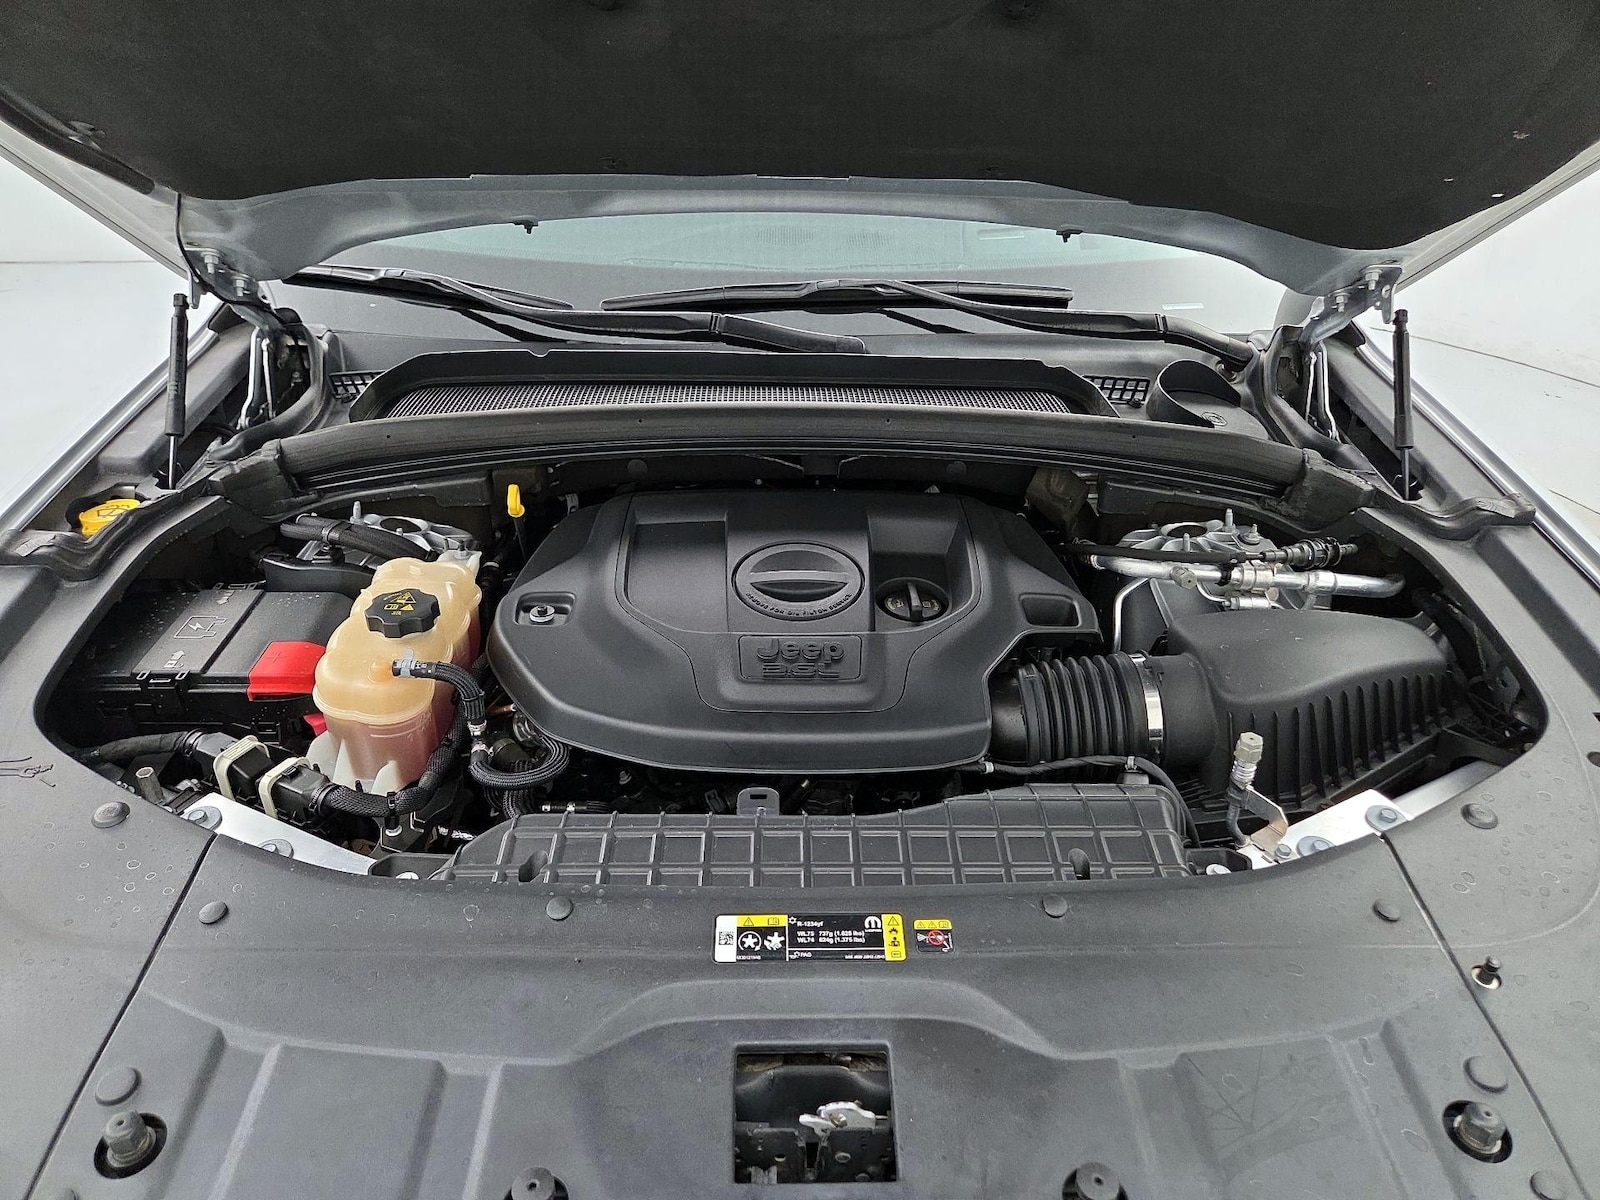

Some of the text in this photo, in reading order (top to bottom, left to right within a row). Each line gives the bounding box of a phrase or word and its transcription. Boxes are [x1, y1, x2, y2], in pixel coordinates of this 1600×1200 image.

[769, 607, 785, 615] FOR
[756, 638, 845, 664] Jeep
[761, 662, 840, 680] 3.6L
